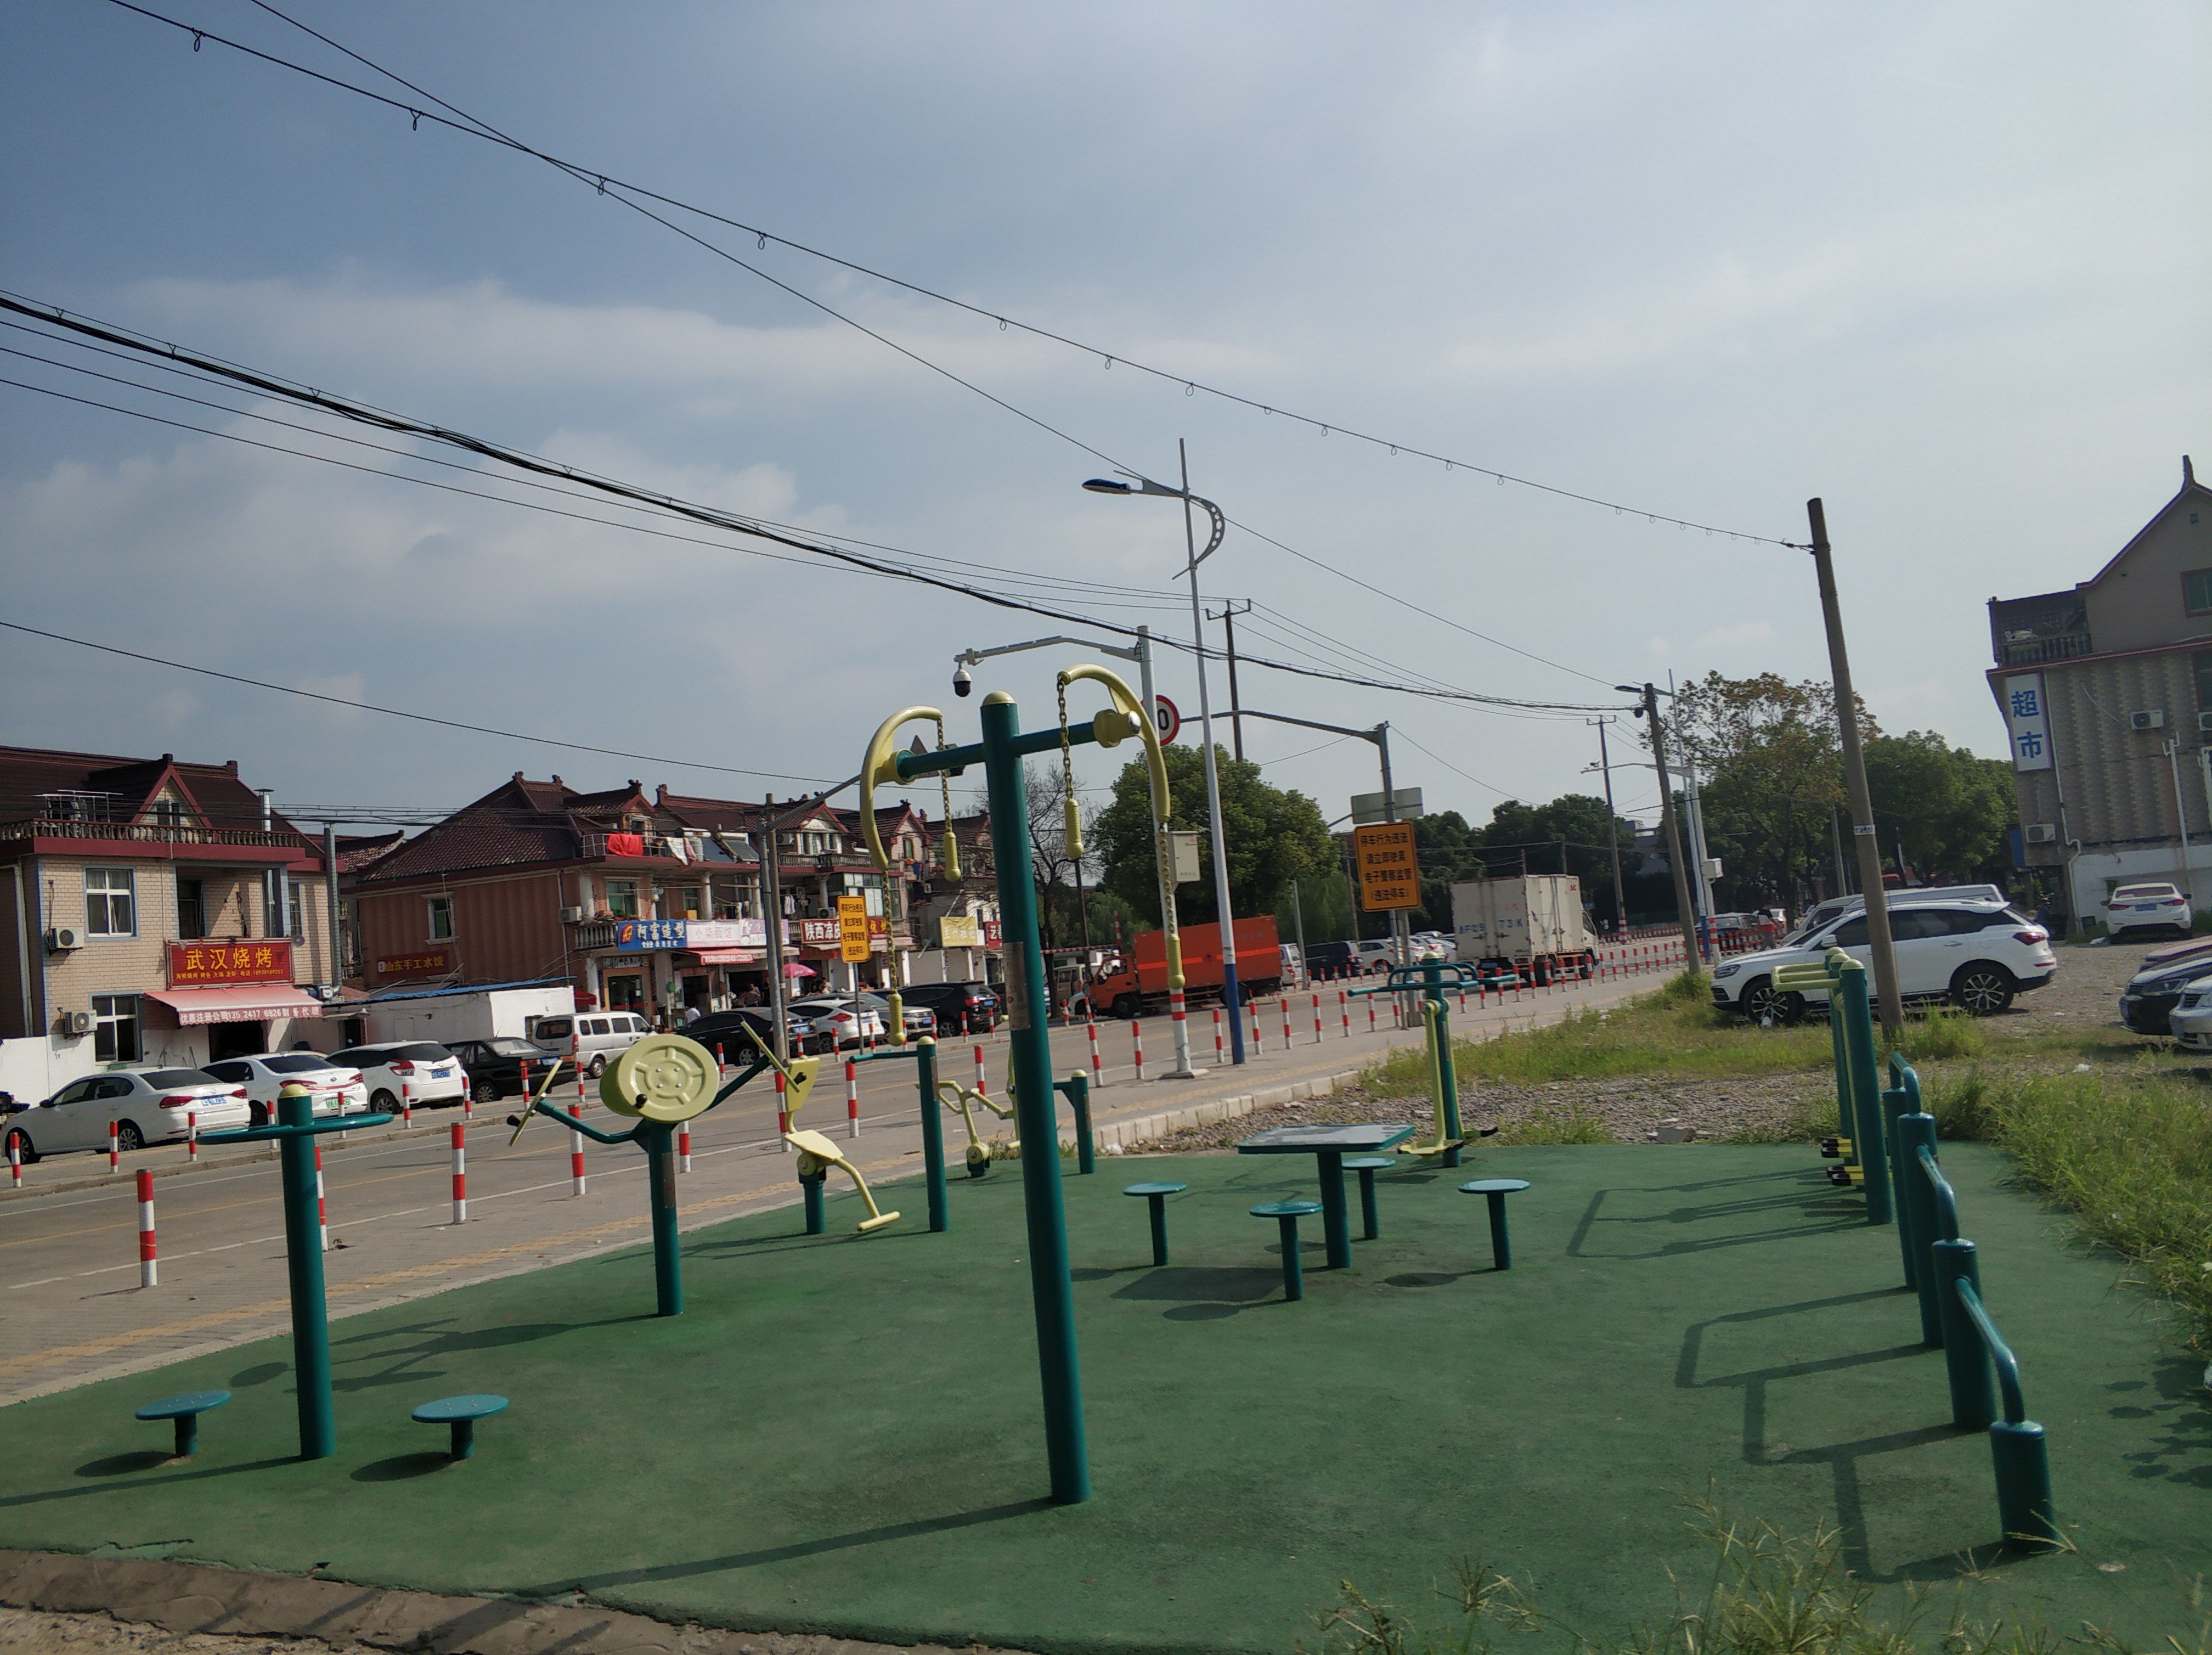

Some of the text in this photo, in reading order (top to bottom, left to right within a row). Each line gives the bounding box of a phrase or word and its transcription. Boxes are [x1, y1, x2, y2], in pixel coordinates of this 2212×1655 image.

[1157, 708, 1169, 730] 0
[2011, 690, 2044, 758] 超市
[1361, 832, 1408, 847] 停车行为违法
[1366, 851, 1406, 864] 请立即驶离
[1365, 868, 1412, 883] 电子警察监管
[636, 921, 685, 941] 阿富造型
[185, 947, 273, 971] 武汉烧烤
[386, 955, 444, 972] 山东手工水饺
[243, 1010, 261, 1019] 2417
